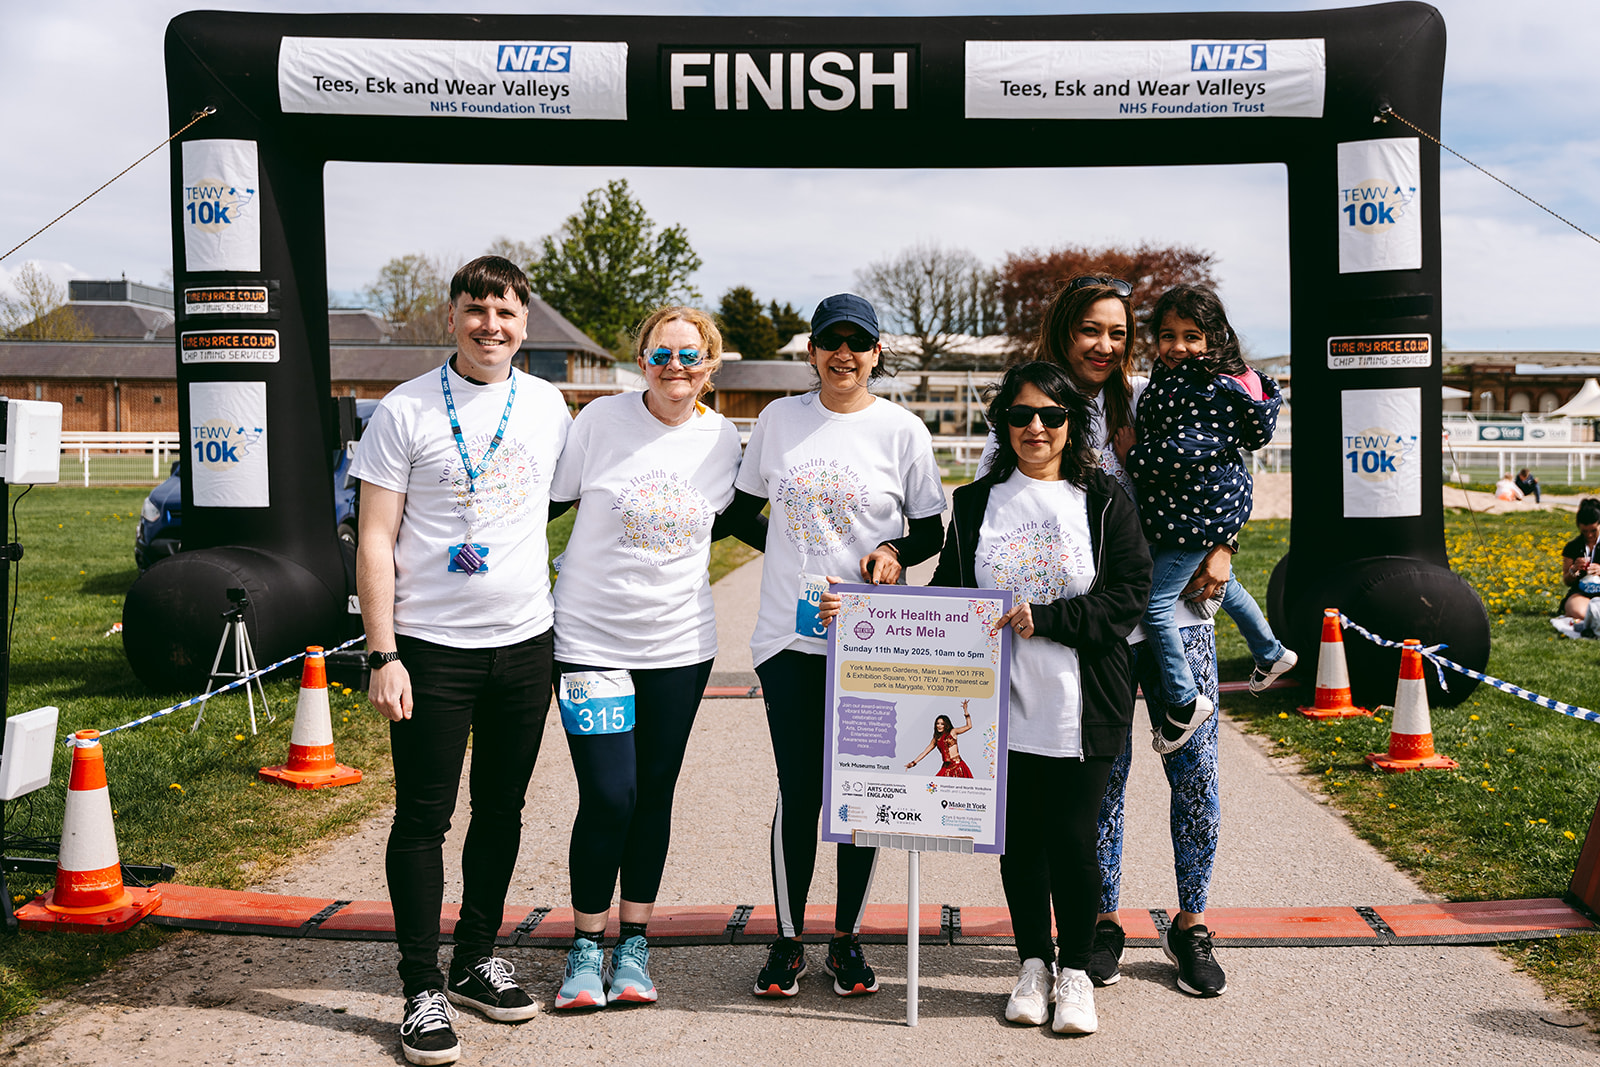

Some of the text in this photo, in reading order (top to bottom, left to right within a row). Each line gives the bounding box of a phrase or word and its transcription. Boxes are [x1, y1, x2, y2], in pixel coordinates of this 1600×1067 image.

[498, 46, 568, 71] NHS
[1192, 46, 1266, 70] NHS
[312, 76, 570, 101] Tees, Esk and Wear Valleys
[670, 52, 908, 111] FINISH
[1000, 79, 1265, 99] Tees, Esk and Wear Valleys
[430, 102, 571, 114] NHS Foundation Trust
[1119, 102, 1265, 113] NHS Foundation Trust
[186, 186, 224, 200] TEWV
[1342, 186, 1388, 202] TEWV
[186, 201, 232, 224] 10k
[1343, 202, 1396, 226] 10k
[184, 351, 274, 360] CHIP TIMING SERVICES
[1334, 355, 1427, 366] CHIP TIMING SERVICES
[193, 426, 231, 438] TEWV
[1344, 435, 1390, 448] TEWV
[194, 441, 239, 462] 10k
[439, 456, 456, 484] York
[1346, 450, 1397, 473] 10k
[776, 458, 870, 514] York Health & Arts Mela
[611, 469, 710, 526] York Health & Arts Mela
[982, 520, 1086, 575] York Health & Arts Mela
[806, 582, 827, 591] TEWV
[868, 608, 969, 622] York Health and
[886, 625, 912, 636] Arts
[916, 626, 945, 638] Mela
[843, 644, 872, 653] Sunday
[893, 647, 909, 656] May
[911, 648, 932, 656] 2025,
[967, 650, 984, 659] 5pm
[566, 687, 588, 700] 10k
[578, 706, 625, 732] 315
[890, 811, 922, 822] YORK
